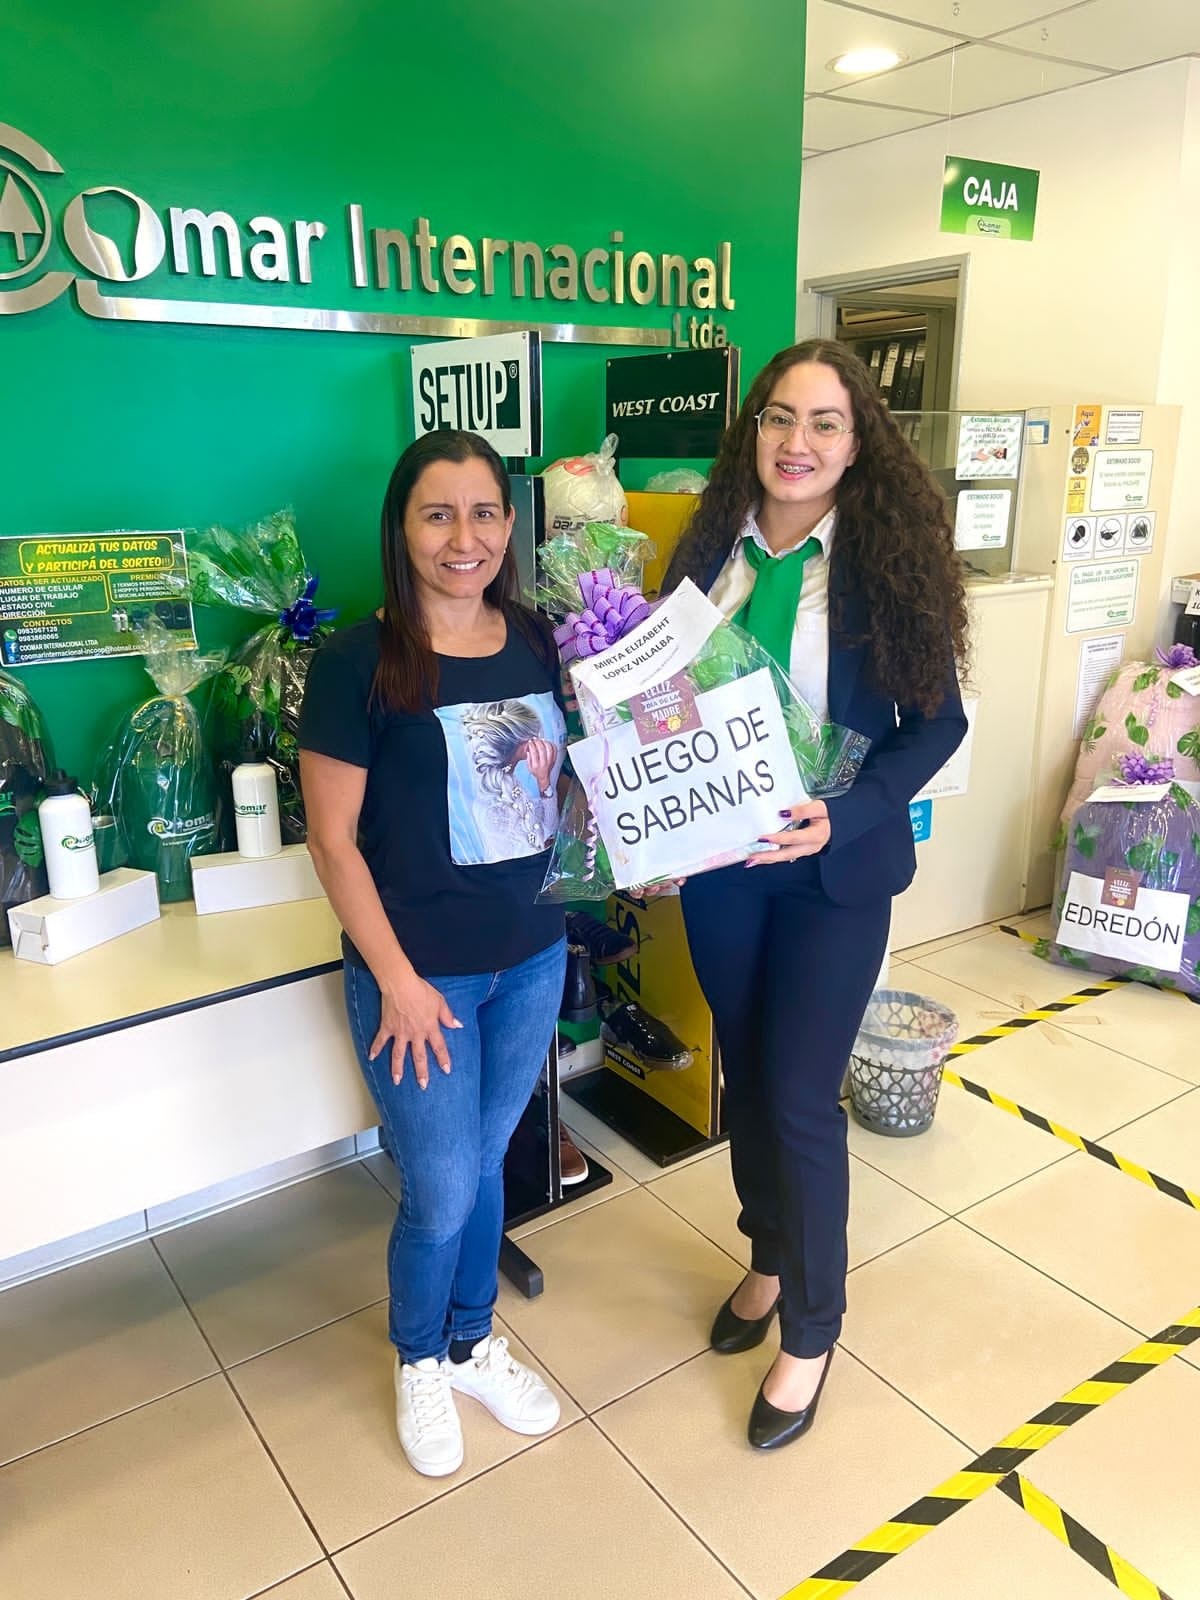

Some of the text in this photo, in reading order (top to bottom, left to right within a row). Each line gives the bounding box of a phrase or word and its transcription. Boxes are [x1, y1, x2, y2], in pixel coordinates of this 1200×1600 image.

[963, 176, 1018, 212] CAJA
[348, 203, 735, 310] Internacional
[611, 392, 720, 419] WEST COAST
[36, 539, 158, 555] ACTUALIZÁ TUS DATOS
[26, 563, 33, 573] Y
[38, 556, 96, 572] PARTICIPÁ
[99, 559, 119, 569] DEL
[42, 592, 78, 600] TRABAJO
[48, 584, 83, 592] CELULAR
[23, 618, 73, 628] CONTACTOS
[20, 644, 43, 652] COOMAR
[44, 641, 84, 649] INTERNACIONAL
[593, 652, 626, 670] MIRTA
[625, 617, 671, 654] ELIZABEHT
[602, 663, 633, 680] LOPEZ
[632, 635, 674, 666] VILLALBA
[645, 680, 672, 698] FELIZ
[669, 694, 678, 702] LA
[652, 704, 680, 721] MADRE
[604, 706, 770, 800] JUEGO DE
[616, 759, 775, 845] SABANAS
[1064, 902, 1181, 945] EDREDÓN
